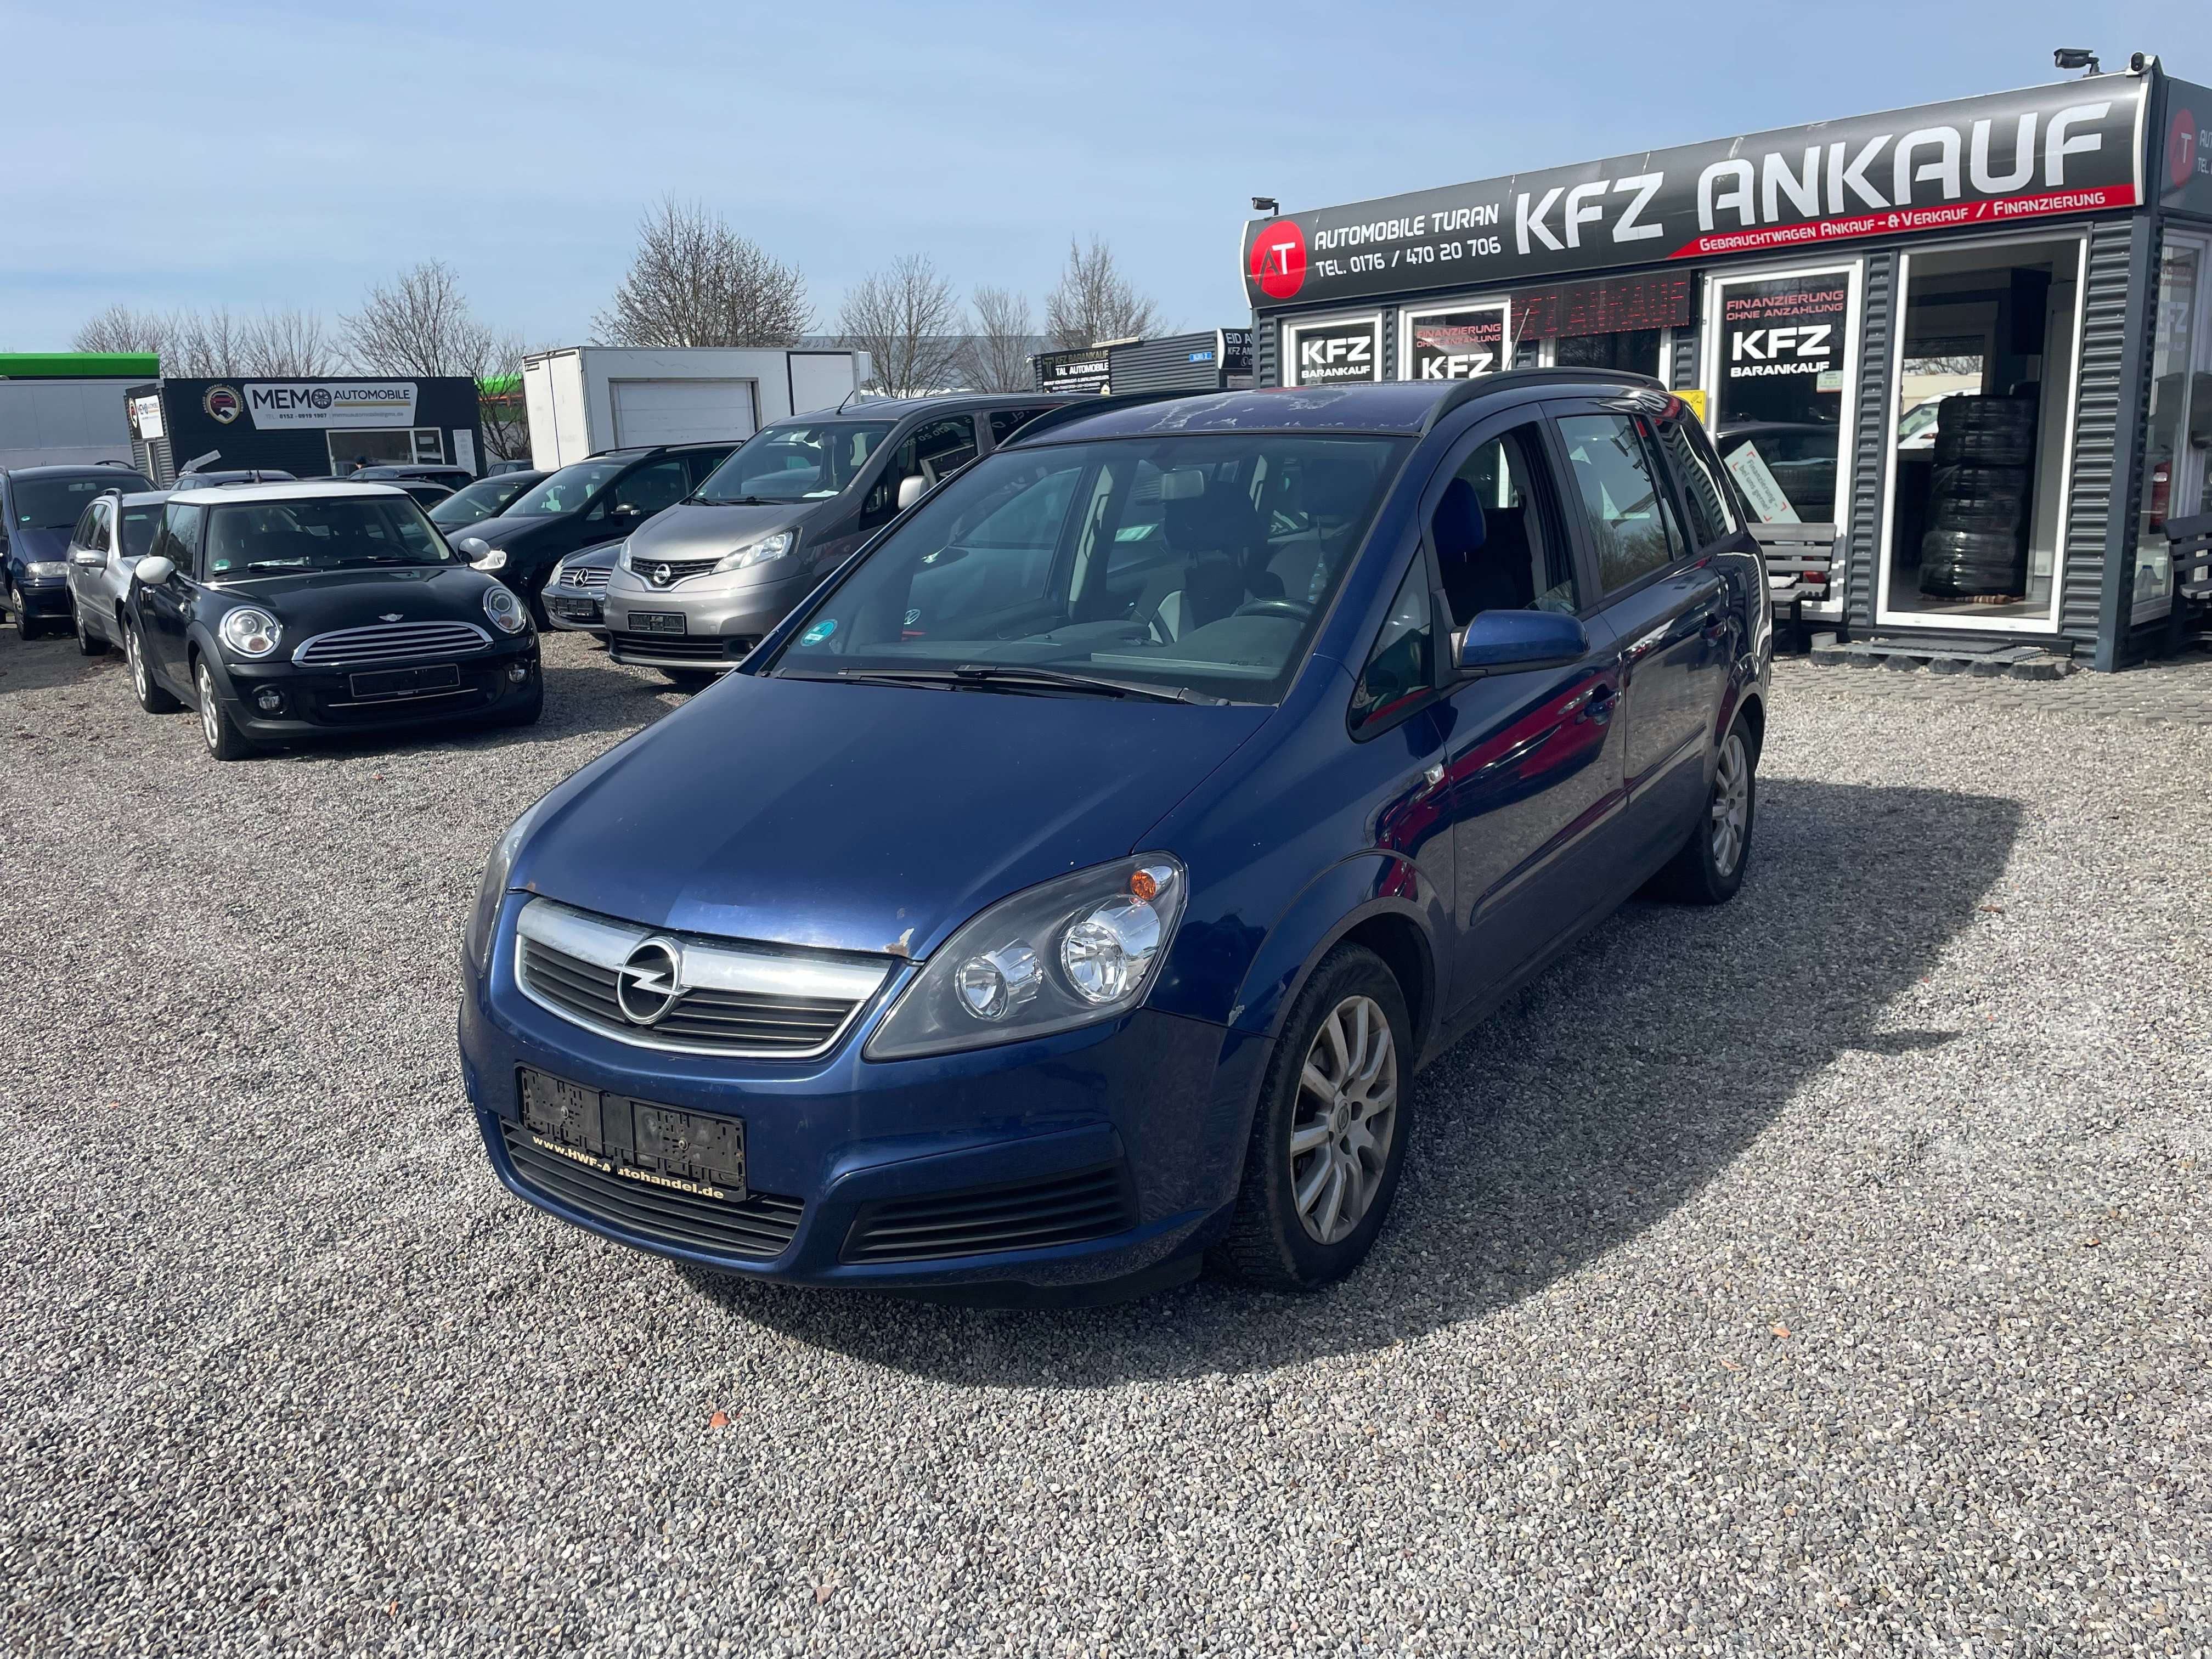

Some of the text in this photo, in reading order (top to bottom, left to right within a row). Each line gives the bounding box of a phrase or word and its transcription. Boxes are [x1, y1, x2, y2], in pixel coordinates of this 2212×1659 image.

[1516, 101, 2112, 255] KFZ ANKAUF
[1314, 204, 1499, 251] AUTOMOBILE TURAN
[1700, 227, 1816, 251] GEBRAUCHTWAGEN
[1820, 219, 1875, 237] ANKAUF
[1901, 208, 1969, 227] VERKAUF
[1993, 192, 2106, 216] FINANZIERUNG
[1259, 242, 1295, 285] AT
[1316, 236, 1502, 277] TEL. 0176 / 470 20 706
[1726, 290, 1844, 311] FINANZIERUNG
[1726, 303, 1843, 321] OHNE ANZAHLUNG
[1225, 332, 1253, 344] EID A
[1416, 323, 1502, 338] FINANZIERUNG
[1227, 346, 1240, 355] KFZ
[1302, 335, 1372, 365] KFZ
[1731, 324, 1832, 361] KFZ
[1068, 349, 1109, 362] BARANKAUF
[1055, 362, 1109, 376] TAL AUTOMOBILE
[1301, 365, 1371, 379] BARANKAUF
[1422, 352, 1493, 380] KFZ
[1730, 361, 1830, 378] BARANKAUF
[334, 390, 410, 400] AUTOMOBILE
